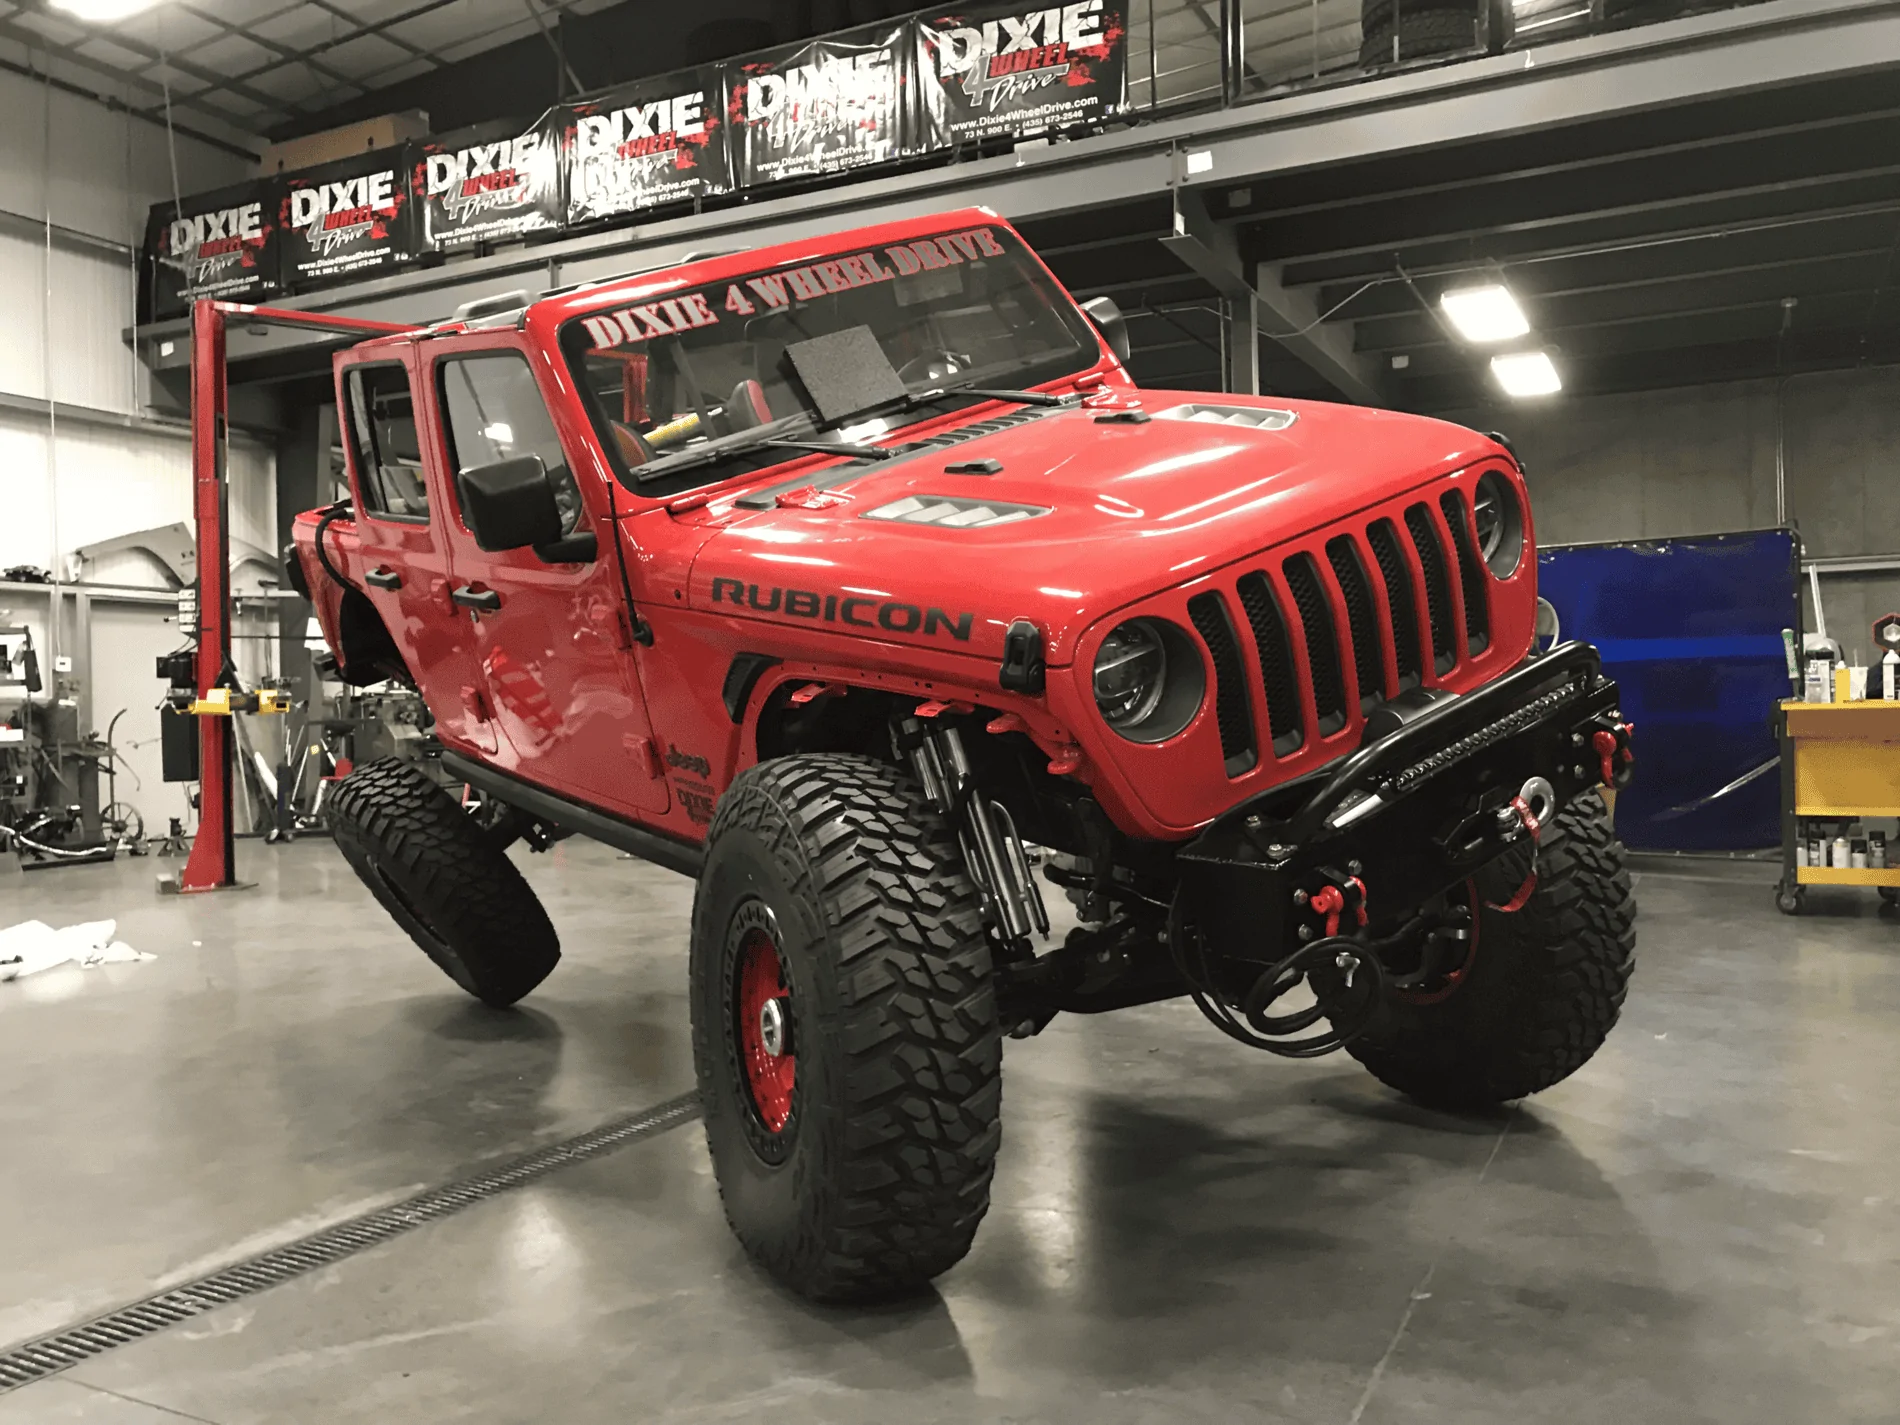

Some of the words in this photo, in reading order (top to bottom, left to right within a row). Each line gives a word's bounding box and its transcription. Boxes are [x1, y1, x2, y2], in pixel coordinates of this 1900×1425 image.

[939, 0, 1104, 77] DIXIE
[989, 42, 1070, 77] WHEEL
[989, 73, 1057, 113] Drive
[577, 91, 705, 152] DIXIE
[951, 95, 1098, 132] www.Dixie4WheelDrive.com
[964, 129, 975, 139] 73
[976, 127, 985, 137] N.
[987, 124, 1003, 135] 900
[1004, 122, 1012, 132] E.
[1022, 118, 1043, 130] (435)
[1045, 110, 1083, 124] 673-2546
[790, 119, 850, 154] Drive
[427, 132, 541, 195] DIXIE
[462, 168, 517, 197] WHEEL
[291, 170, 394, 228] DIXIE
[324, 204, 373, 230] WHEEL
[170, 202, 262, 256] DIXIE
[323, 228, 367, 257] Drive
[581, 293, 720, 350] DIXIE
[724, 284, 755, 316] 4
[746, 252, 896, 309] WHEEL
[884, 227, 1006, 276] DRIVE
[711, 577, 974, 642] RUBICON
